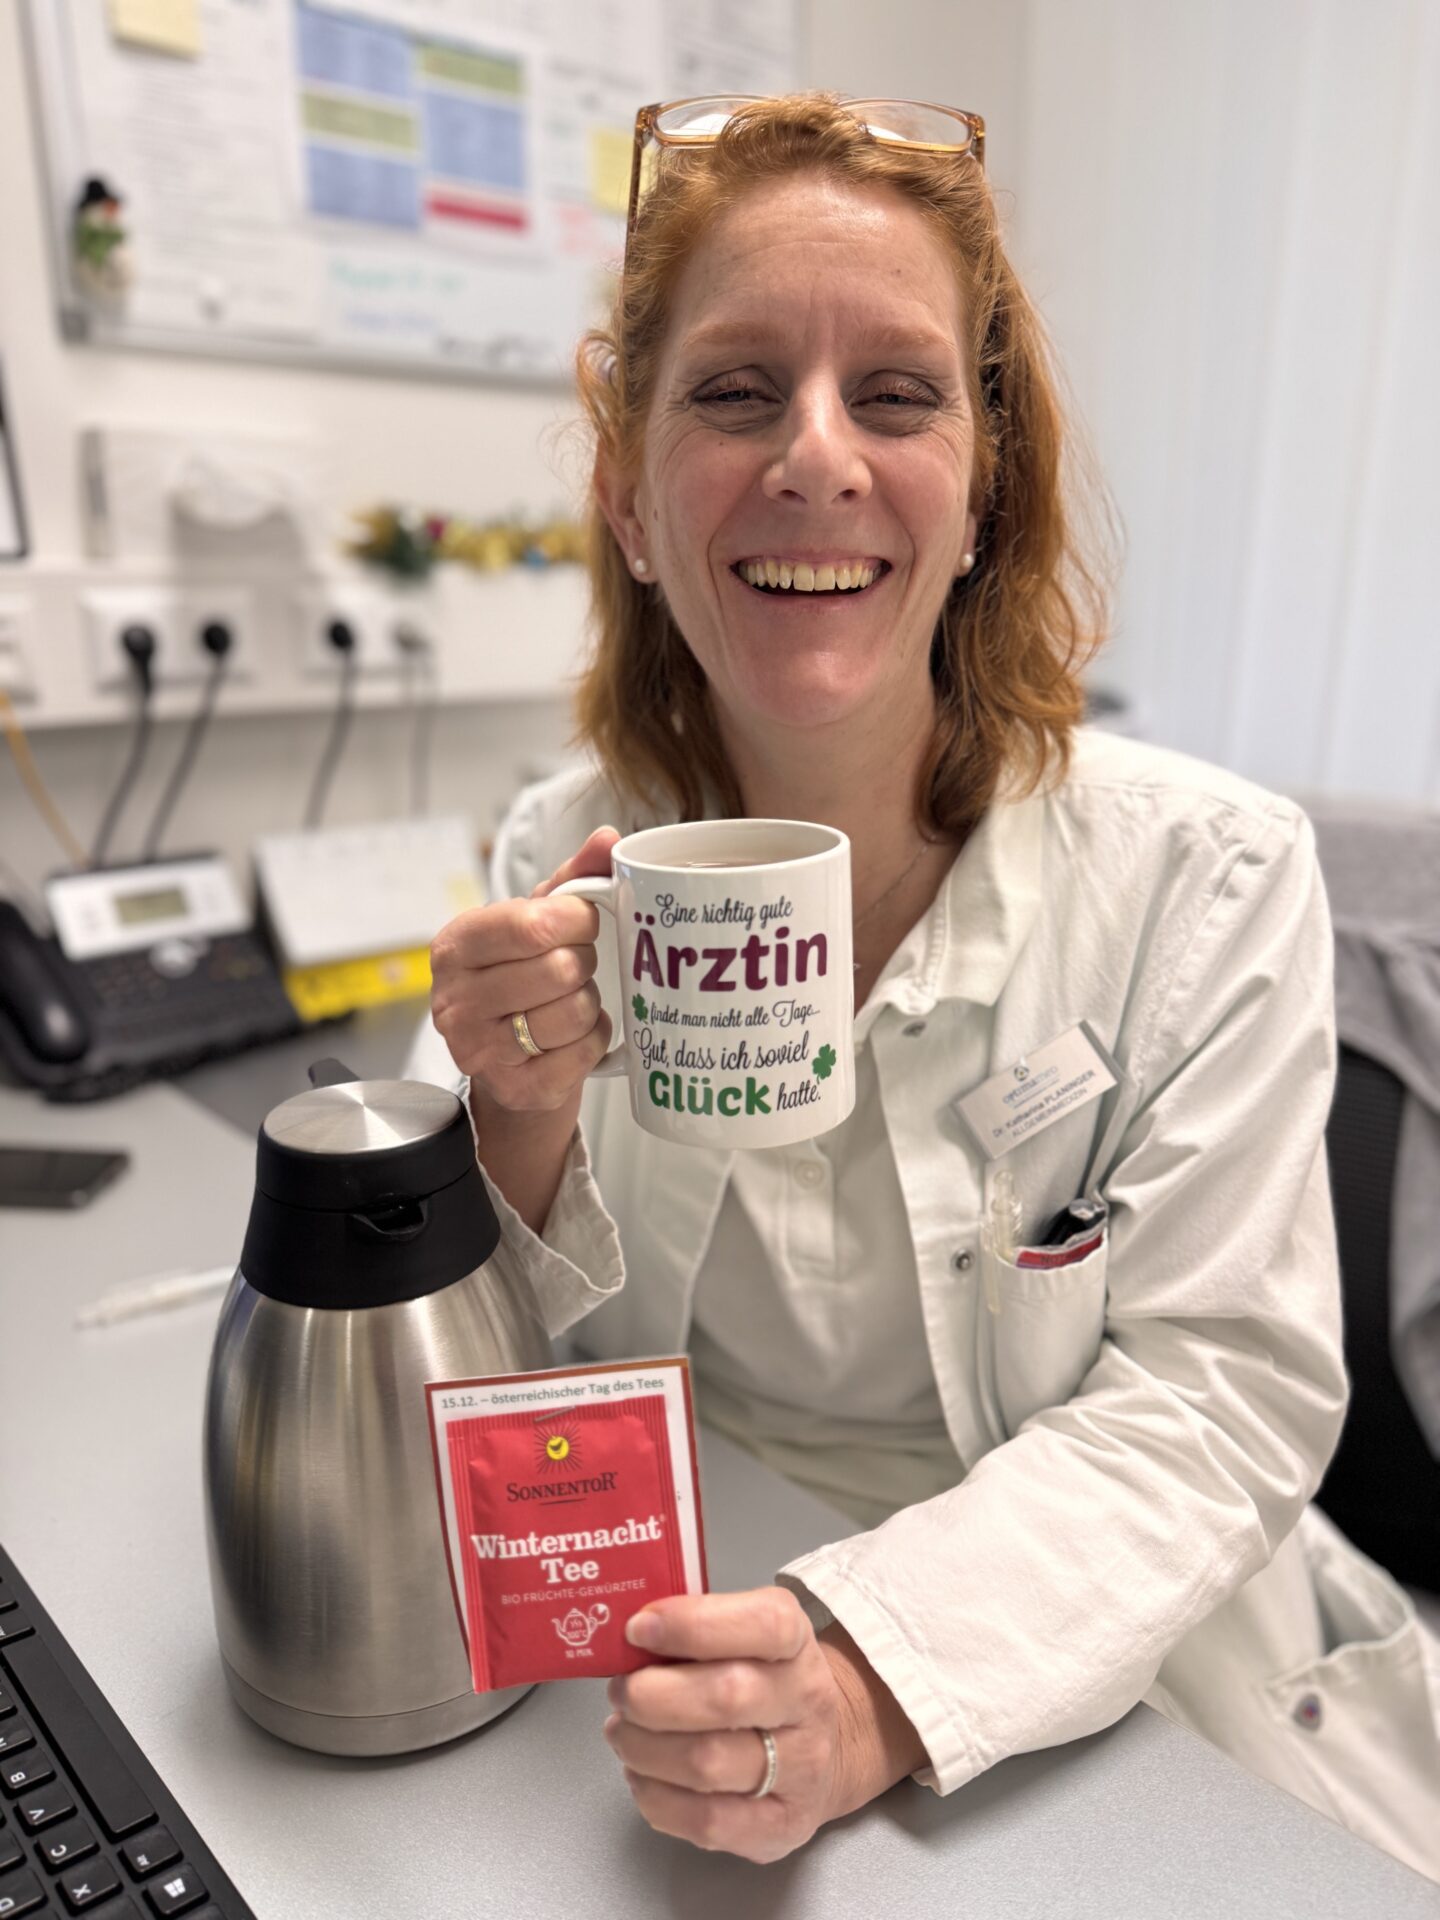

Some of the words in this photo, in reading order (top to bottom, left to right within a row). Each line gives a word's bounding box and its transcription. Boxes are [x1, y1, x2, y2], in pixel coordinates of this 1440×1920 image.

[655, 893, 698, 928] Eine
[701, 898, 755, 931] richtig
[759, 895, 793, 929] gute
[633, 911, 827, 992] Ärztin
[650, 1002, 679, 1025] findet
[681, 1013, 708, 1027] man
[710, 1008, 743, 1028] nicht
[745, 1006, 770, 1027] alle
[633, 1027, 670, 1070] Gut,
[675, 1039, 716, 1070] dass
[720, 1040, 751, 1070] ich
[753, 1030, 810, 1069] soviel
[648, 1070, 772, 1117] Glück
[776, 1079, 821, 1111] hatte.
[441, 1396, 478, 1409] 15.12.
[491, 1385, 586, 1405] österreichischer
[588, 1382, 610, 1397] Tag
[613, 1379, 634, 1392] des
[636, 1377, 665, 1390] Tees
[540, 1557, 600, 1584] Tee
[501, 1594, 521, 1605] BIO
[523, 1578, 647, 1602] FRÜCHTE-GEWÜRZTEE
[10, 1770, 26, 1783] B
[28, 1808, 45, 1820] V
[50, 1844, 67, 1857] C
[72, 1883, 91, 1899] X
